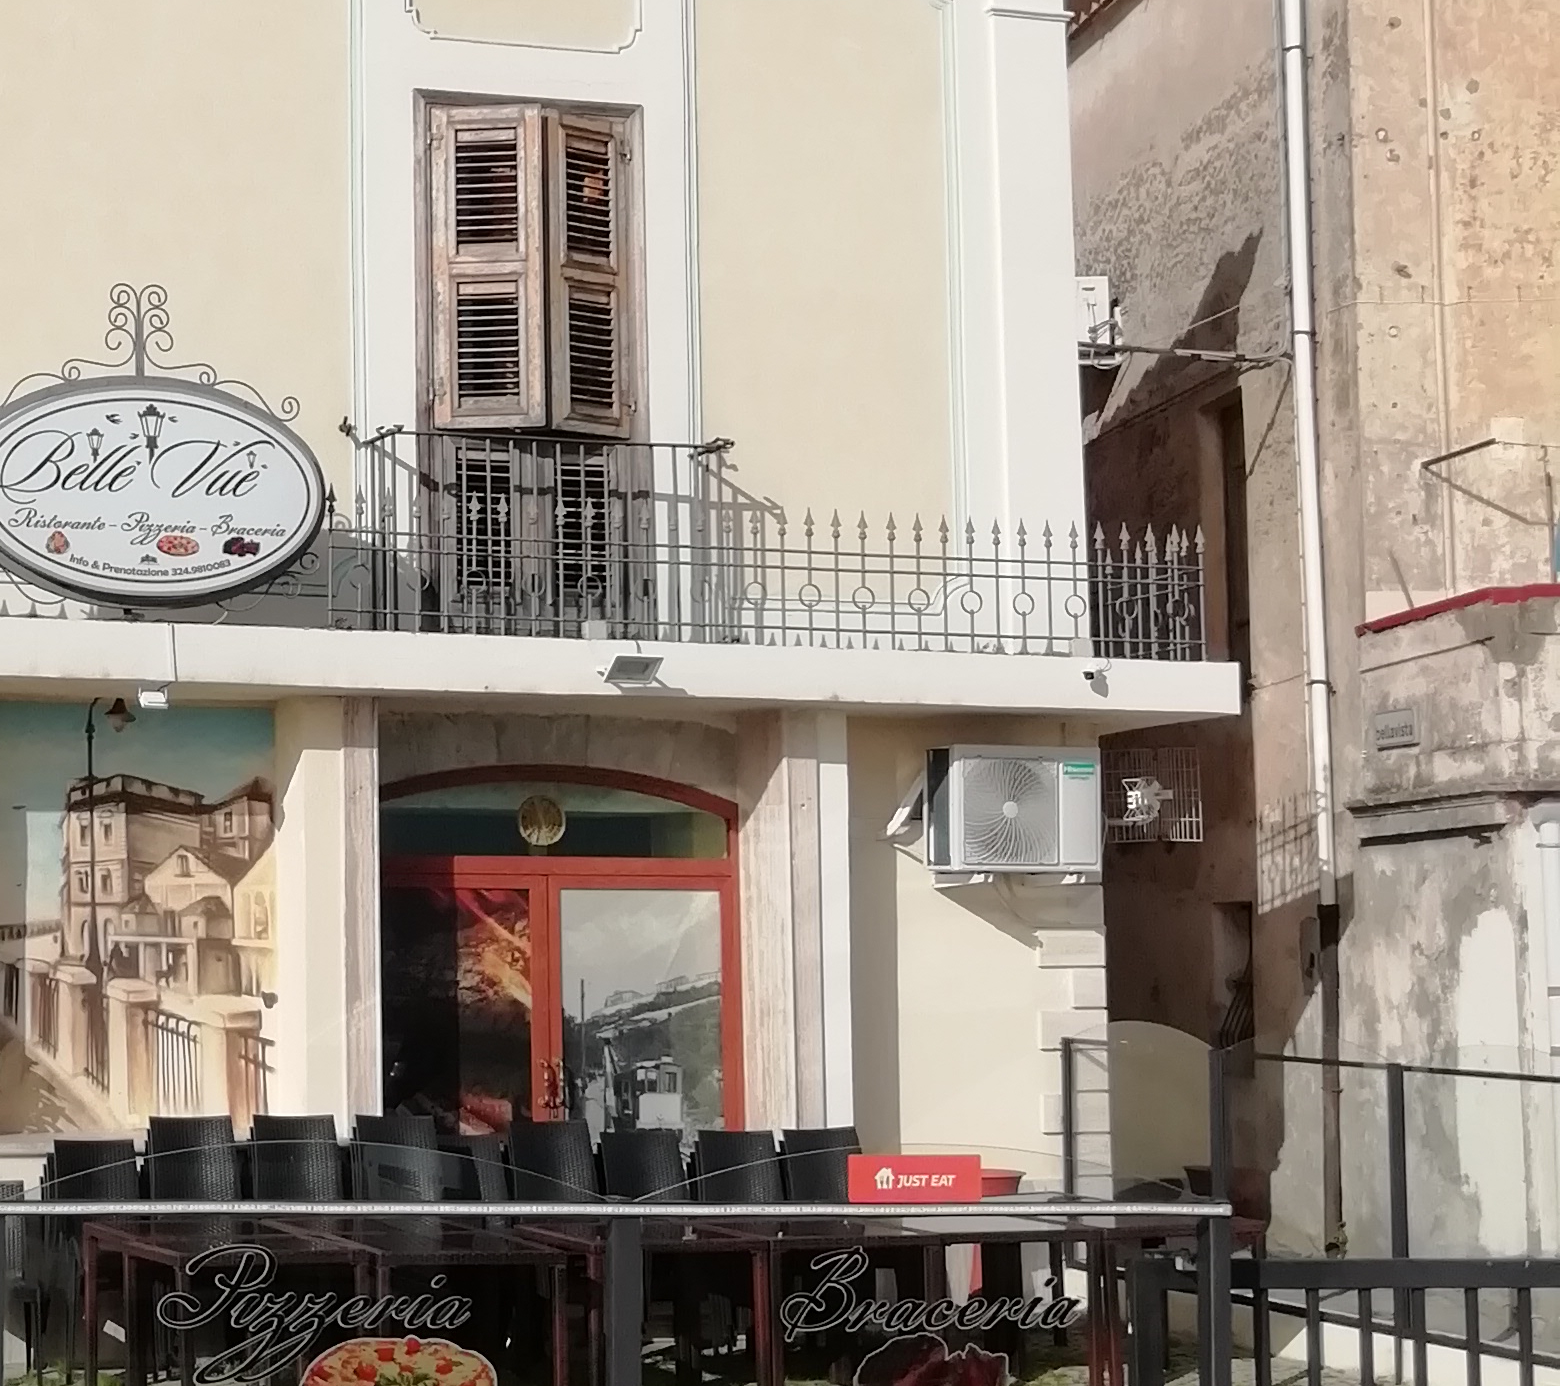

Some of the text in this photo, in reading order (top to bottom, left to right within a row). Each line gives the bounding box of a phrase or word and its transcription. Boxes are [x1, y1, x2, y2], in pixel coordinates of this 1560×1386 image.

[150, 439, 276, 498] Vue
[7, 507, 106, 530] Ristorante
[120, 511, 197, 545] Pizzeria
[210, 513, 287, 537] Braceria
[69, 553, 89, 567] Info
[102, 562, 170, 577] Prenotazione
[897, 1174, 956, 1188] JUST EAT
[156, 1243, 472, 1385] Pizzeria
[780, 1245, 1082, 1342] Braceria
